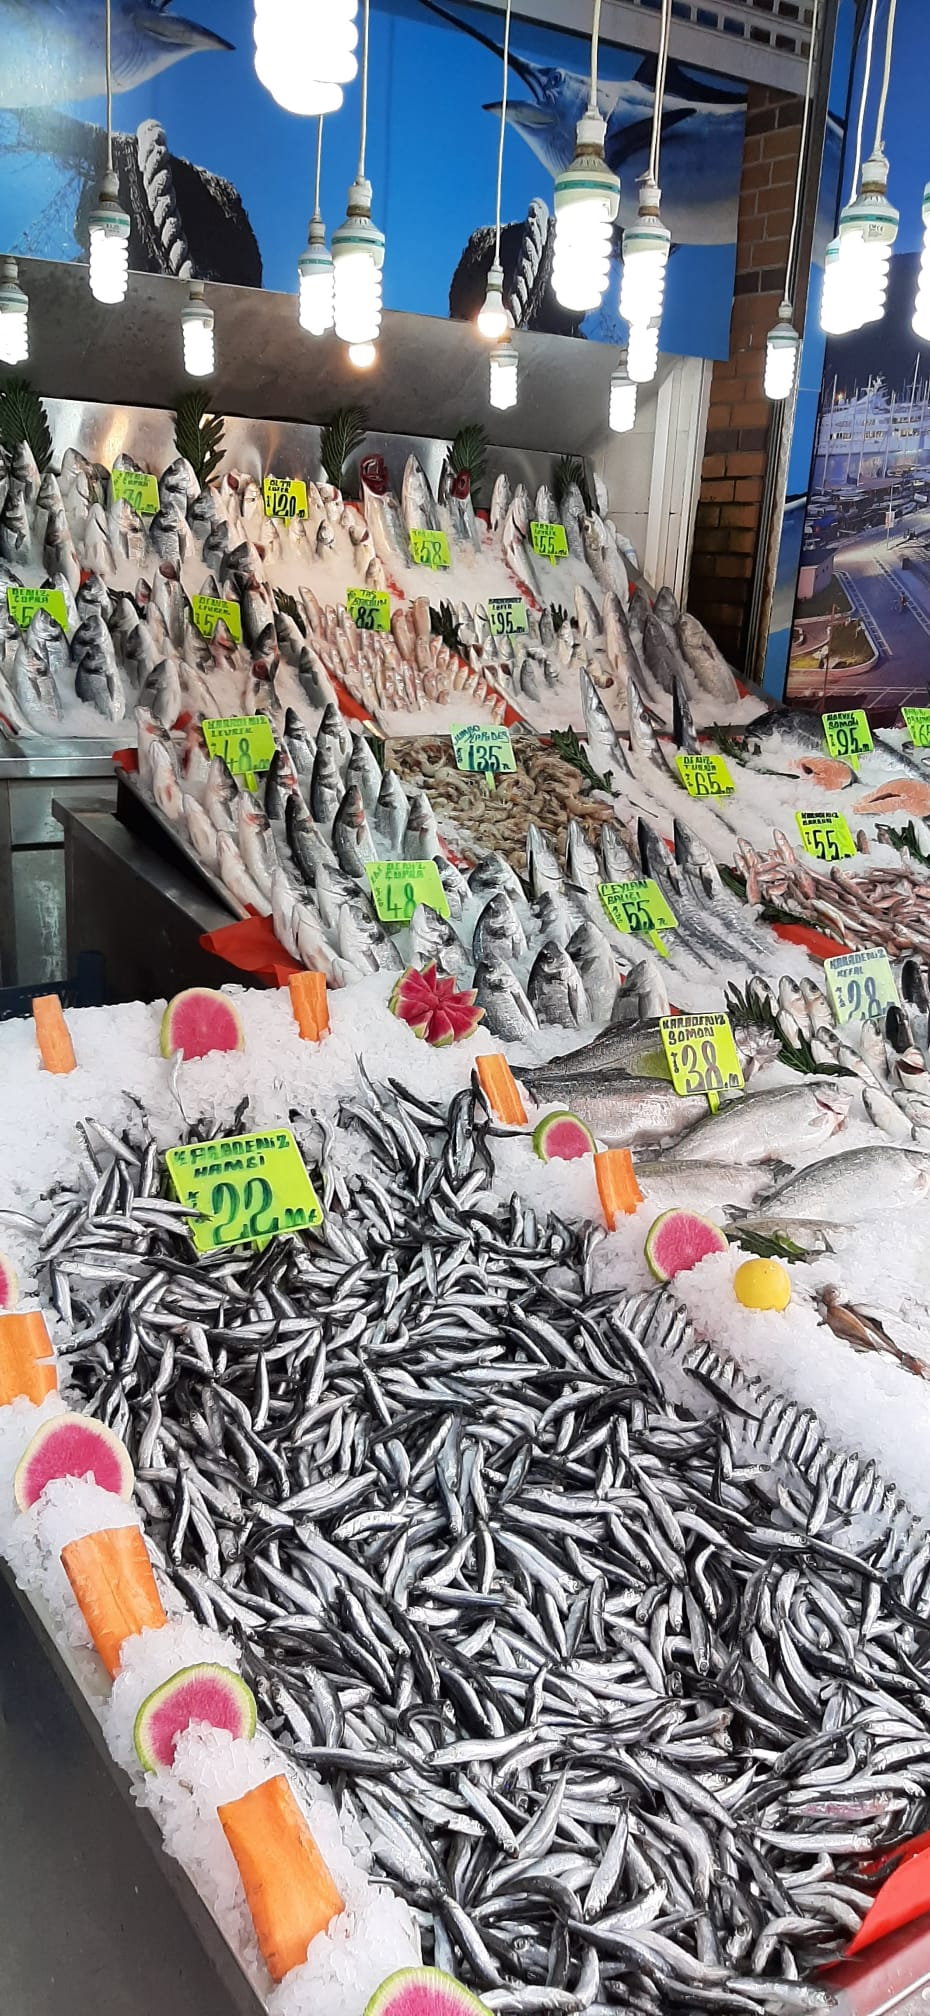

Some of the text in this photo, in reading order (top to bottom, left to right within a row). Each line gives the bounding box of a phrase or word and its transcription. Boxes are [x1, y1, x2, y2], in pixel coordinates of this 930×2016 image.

[468, 744, 502, 773] 135
[601, 879, 649, 897] CEYLAN
[621, 900, 656, 932] 55
[668, 1026, 715, 1045] SOMON
